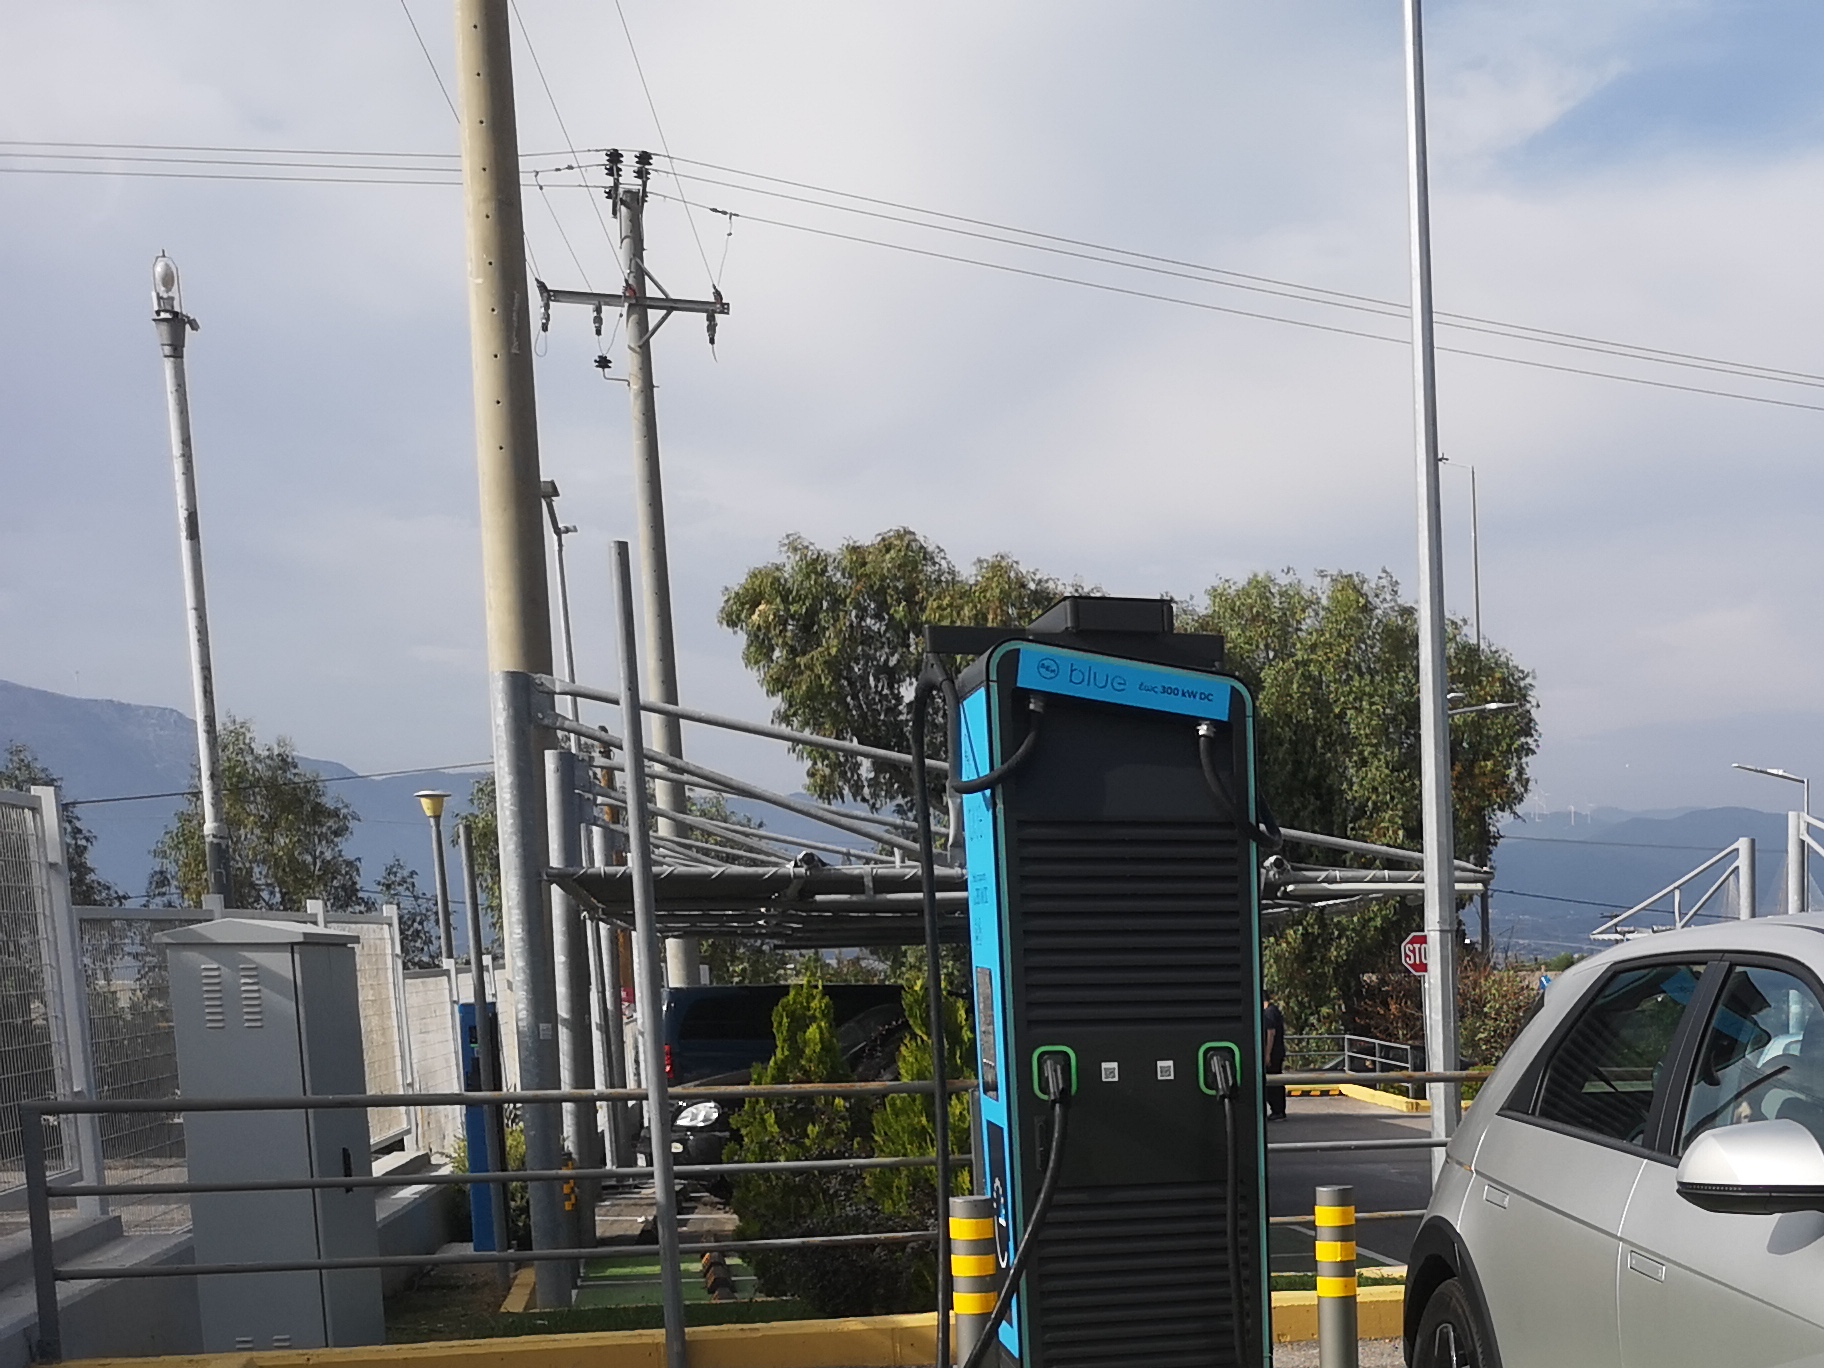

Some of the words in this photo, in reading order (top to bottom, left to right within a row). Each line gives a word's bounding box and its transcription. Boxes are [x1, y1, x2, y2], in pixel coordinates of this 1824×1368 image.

[1069, 663, 1127, 692] blue
[1160, 685, 1179, 697] 300
[1199, 691, 1214, 702] DC
[1405, 943, 1428, 964] STO
